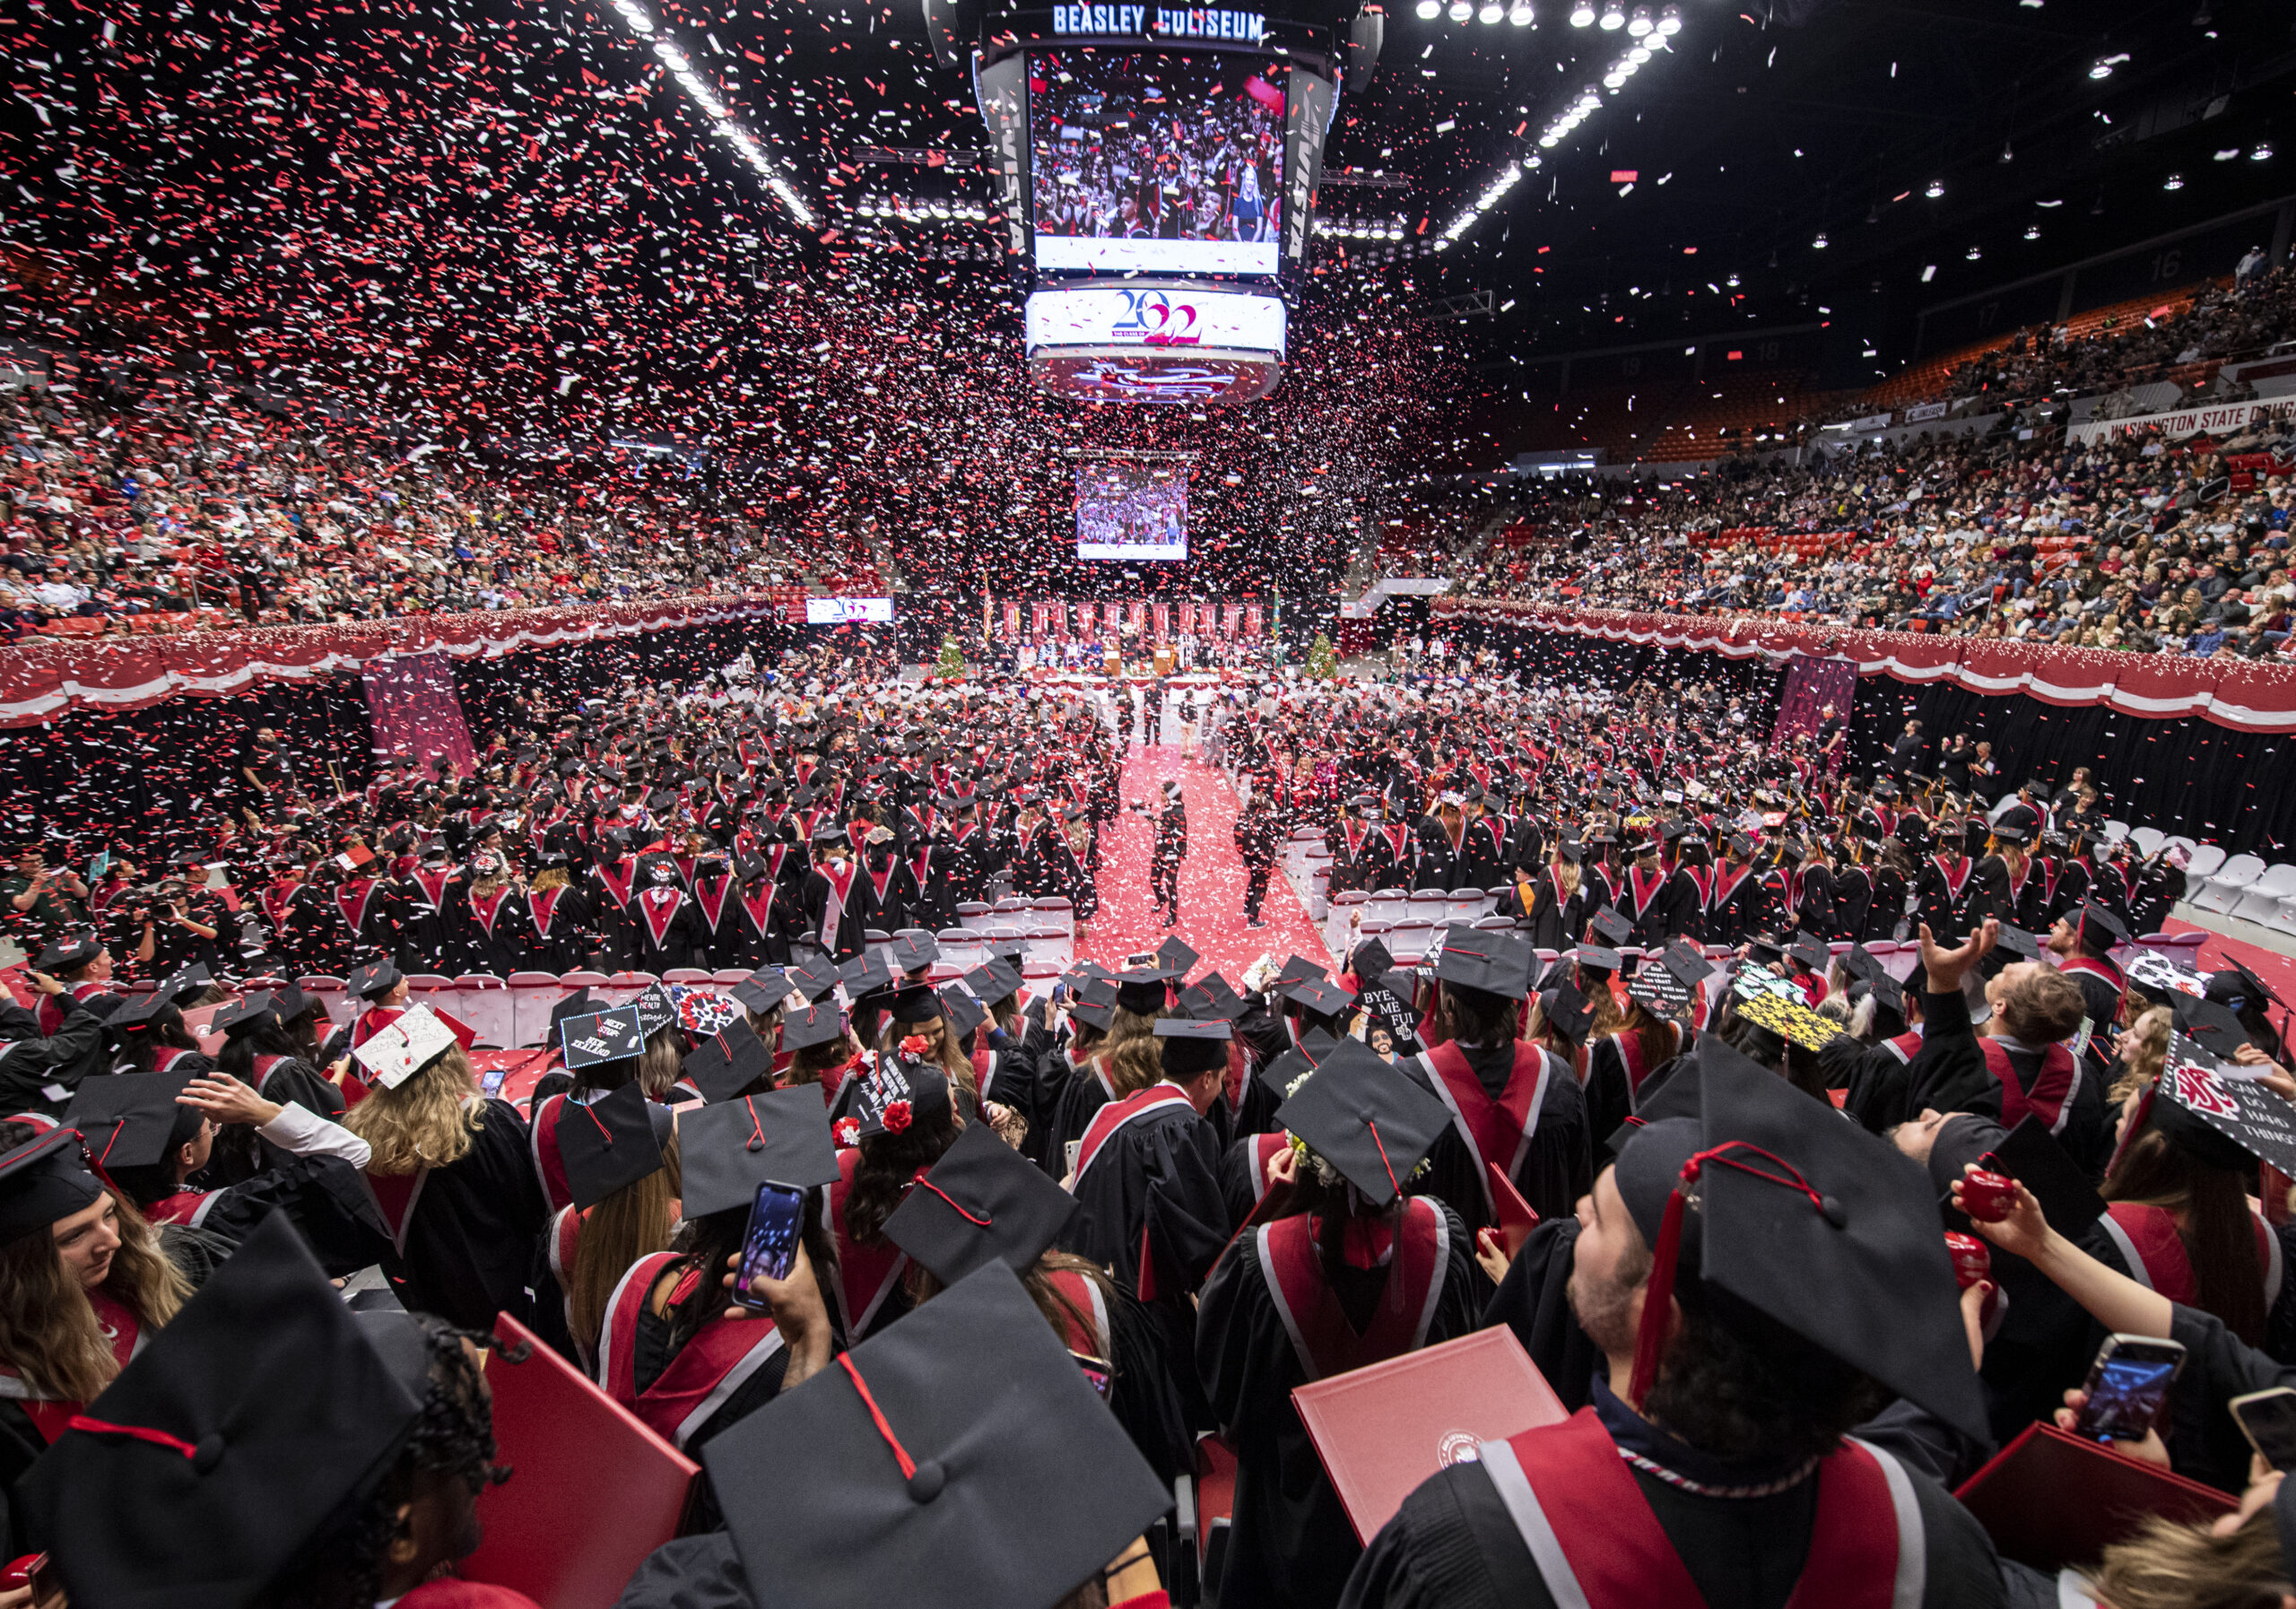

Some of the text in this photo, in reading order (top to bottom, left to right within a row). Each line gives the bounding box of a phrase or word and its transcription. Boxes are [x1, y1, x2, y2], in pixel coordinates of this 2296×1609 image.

[1053, 5, 1264, 40] BEASLEY COLISEUM
[2152, 251, 2182, 281] 16
[1112, 290, 1203, 344] 2022
[1979, 302, 2000, 327] 17
[1757, 342, 1779, 361] 18
[1621, 356, 1642, 376] 19
[2201, 407, 2245, 429] STATE
[1416, 967, 1433, 976] BUT
[640, 994, 661, 1002] MENTAL
[1363, 989, 1396, 1004] BYE,
[1637, 990, 1656, 998] doing
[639, 1002, 660, 1010] HEALTH
[1378, 1001, 1401, 1014] ME
[603, 1018, 627, 1031] NEXT
[1390, 1012, 1414, 1026] FUI
[570, 1039, 611, 1057] ZEALAND
[586, 1036, 608, 1048] NEW
[2227, 1081, 2261, 1097] CAN
[2242, 1095, 2267, 1110] DO
[2245, 1109, 2290, 1129] HARD
